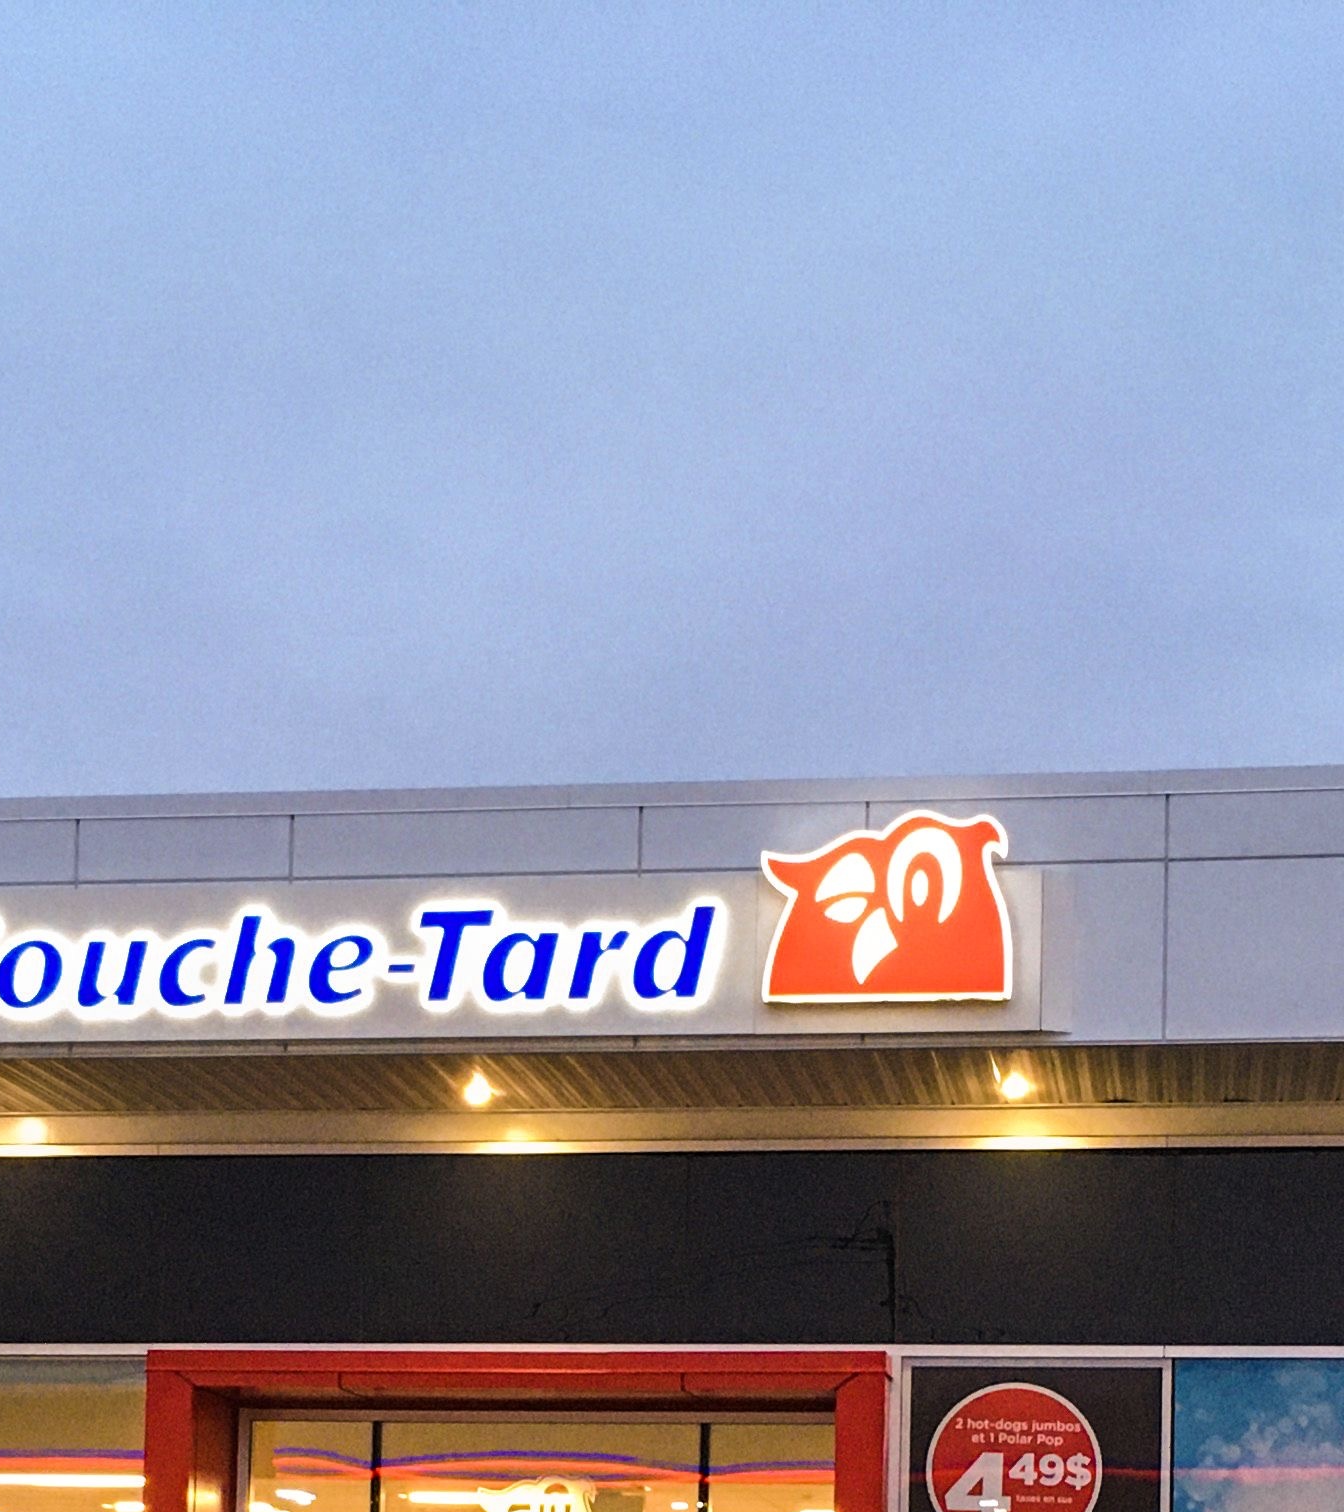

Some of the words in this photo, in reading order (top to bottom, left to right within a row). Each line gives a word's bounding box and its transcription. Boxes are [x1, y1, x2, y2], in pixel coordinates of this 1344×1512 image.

[955, 1418, 963, 1430] 2
[966, 1418, 1028, 1434] hot-dogs
[1031, 1420, 1081, 1433] jumbos
[971, 1433, 985, 1444] et
[989, 1433, 995, 1443] 1
[998, 1432, 1033, 1445] Polar
[1036, 1433, 1064, 1447] Pop
